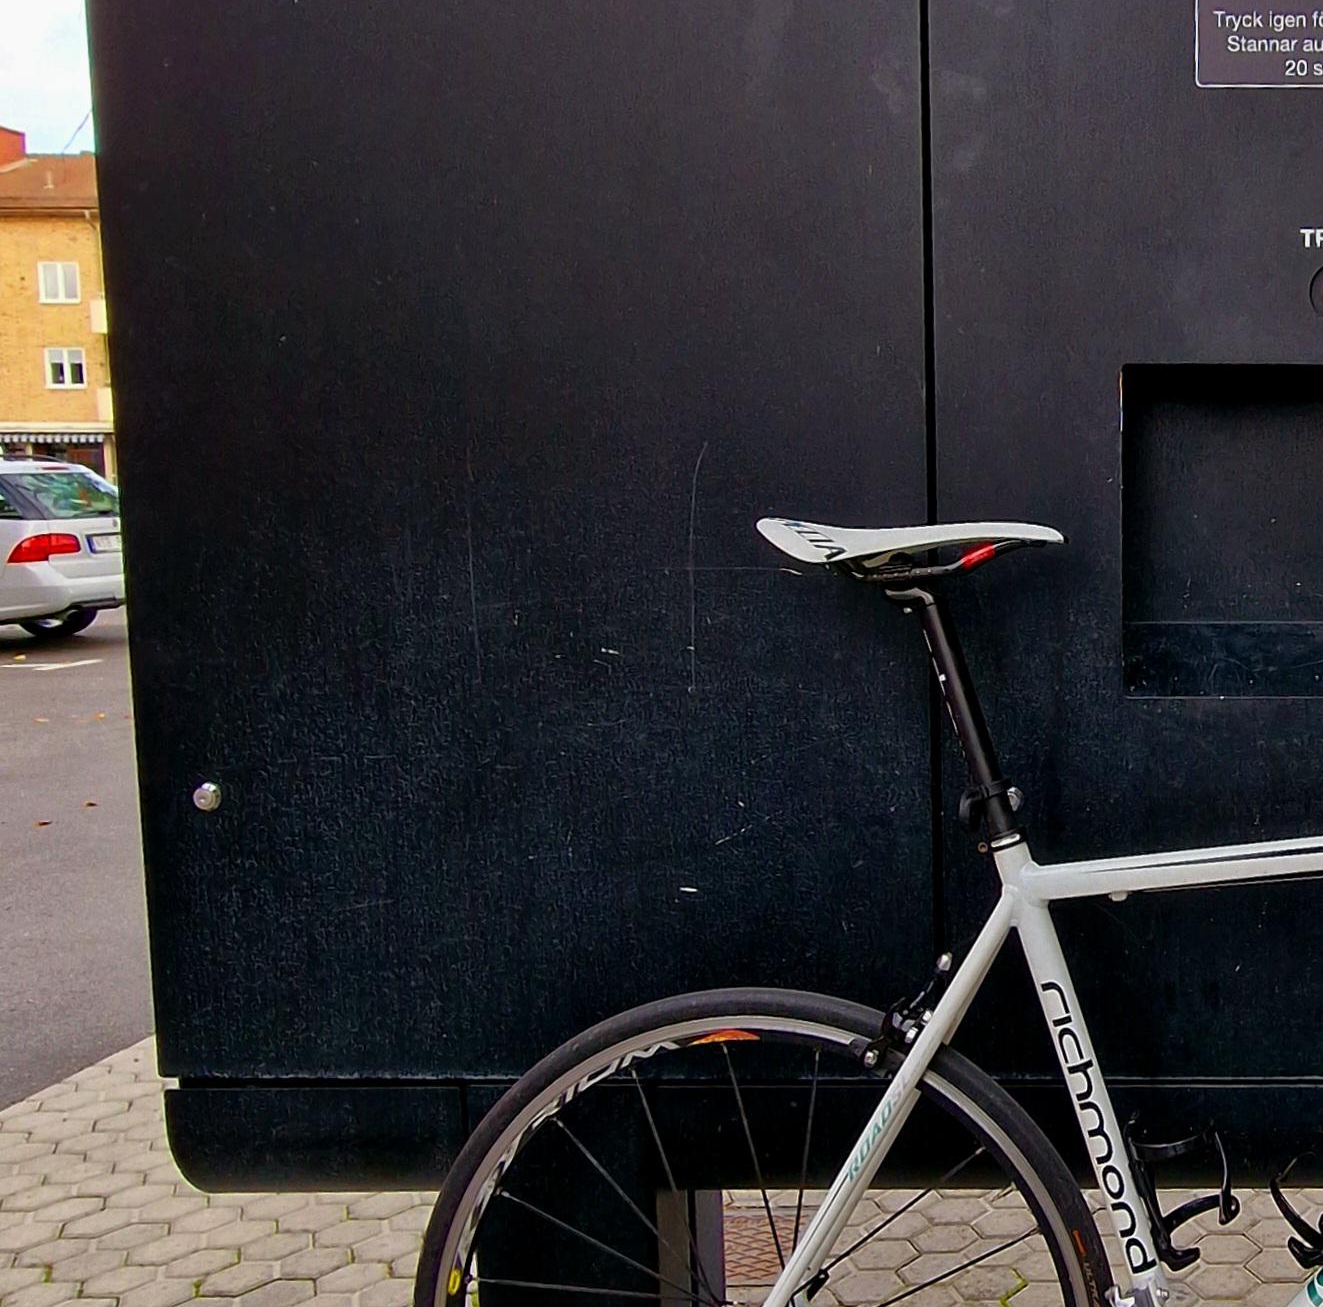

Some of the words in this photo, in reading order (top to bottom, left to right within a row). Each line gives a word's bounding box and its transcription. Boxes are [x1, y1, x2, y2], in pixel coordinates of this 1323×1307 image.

[1212, 10, 1264, 32] Tryck
[1269, 10, 1307, 33] igen
[1227, 35, 1299, 53] Stannar
[1284, 59, 1308, 77] 20
[1041, 980, 1158, 1275] richmond
